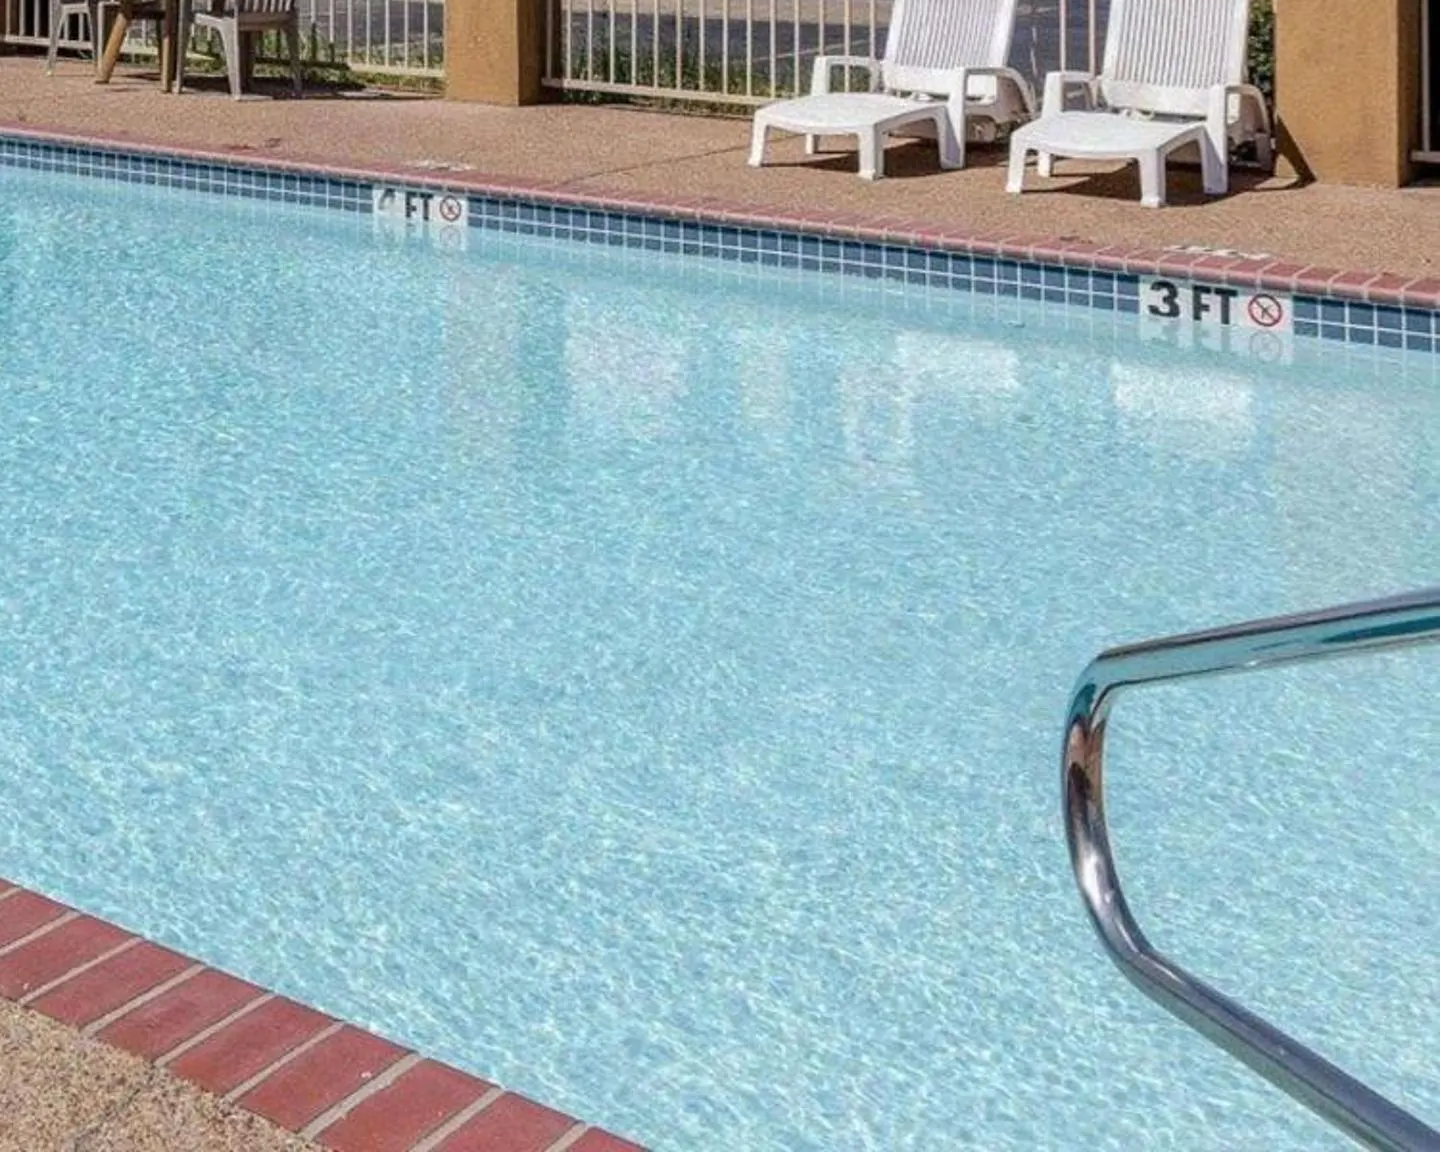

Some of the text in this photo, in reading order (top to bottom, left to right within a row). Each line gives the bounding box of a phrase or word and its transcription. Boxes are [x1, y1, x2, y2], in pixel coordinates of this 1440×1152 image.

[405, 191, 434, 222] FT
[1148, 281, 1238, 325] 3 FT
